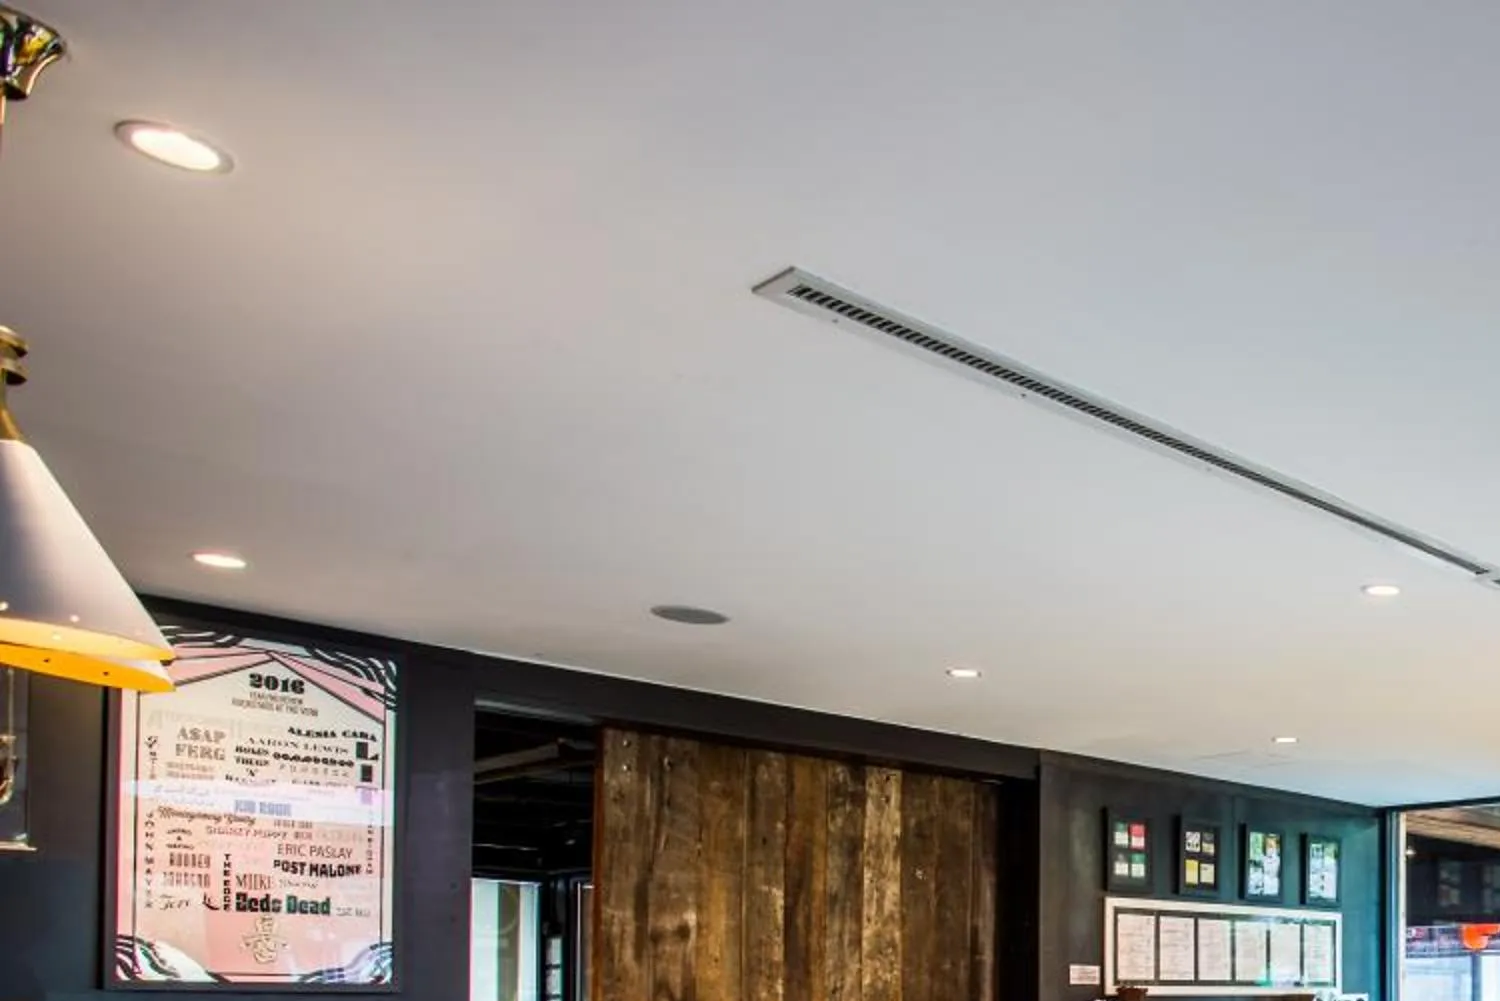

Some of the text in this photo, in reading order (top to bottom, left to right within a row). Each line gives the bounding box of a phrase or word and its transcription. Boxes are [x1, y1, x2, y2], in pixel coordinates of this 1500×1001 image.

[249, 673, 305, 695] 2016
[277, 843, 353, 859] ERIC PASLAY
[273, 859, 307, 876] POST
[286, 893, 332, 916] Dead
